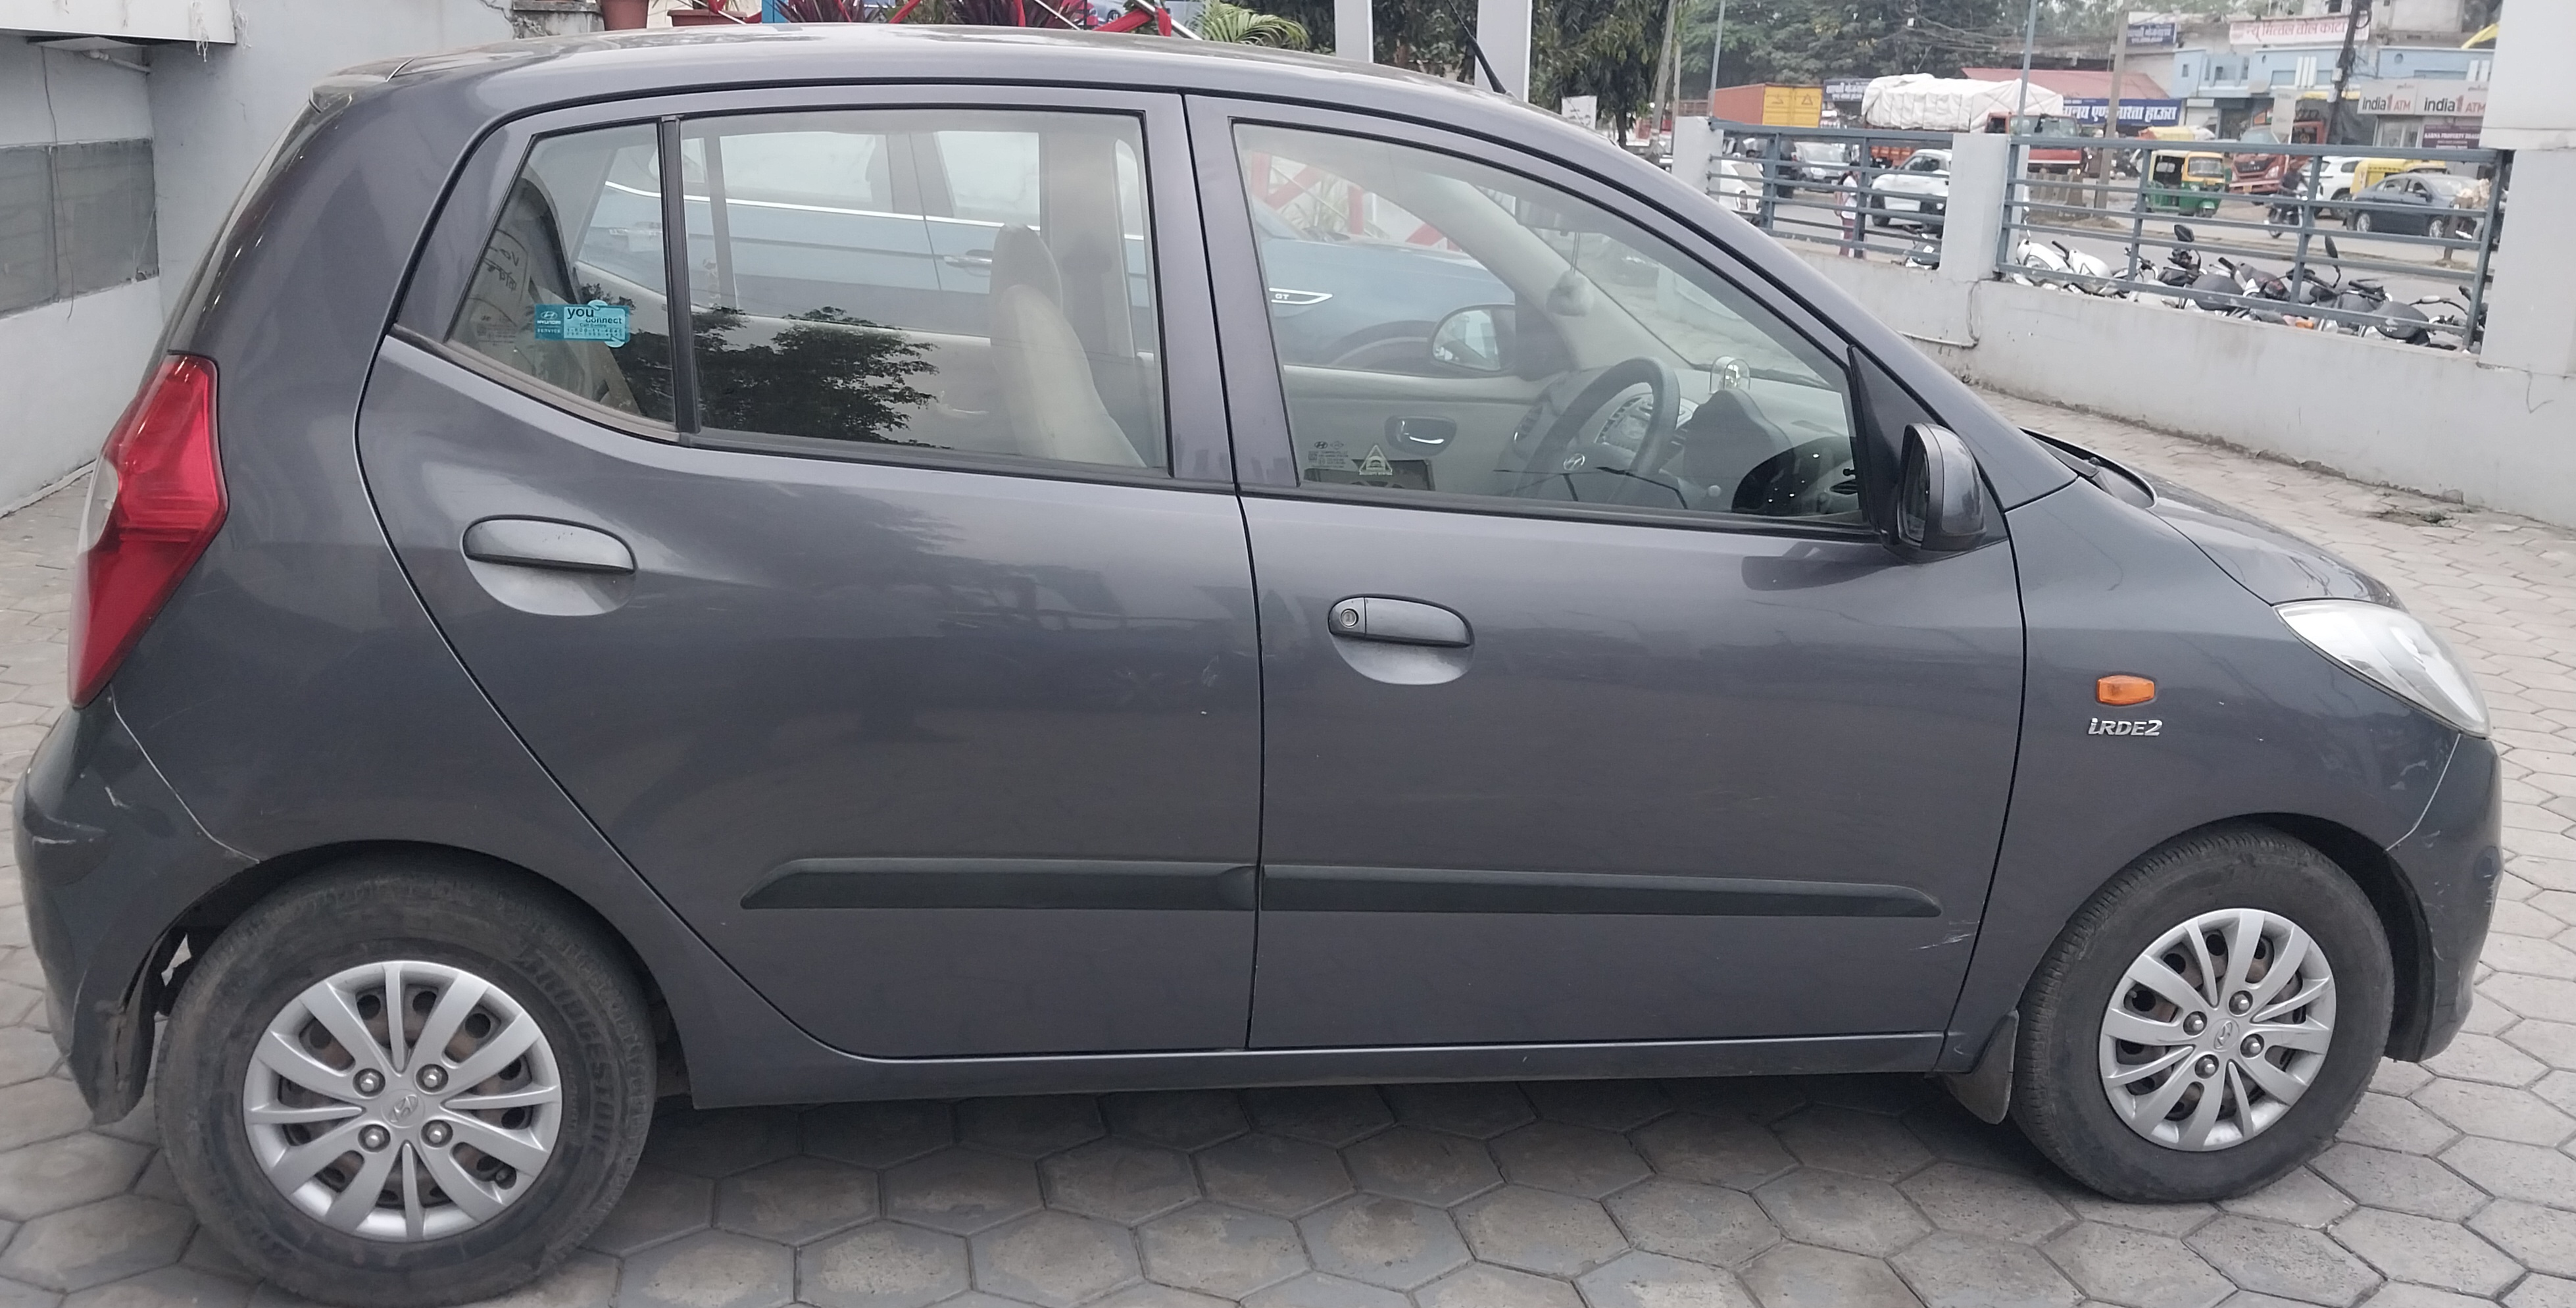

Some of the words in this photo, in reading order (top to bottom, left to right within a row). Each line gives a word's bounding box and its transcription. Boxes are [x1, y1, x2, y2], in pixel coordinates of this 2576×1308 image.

[2394, 100, 2411, 111] ATM
[567, 308, 594, 320] you
[2088, 717, 2163, 736] iRDE2
